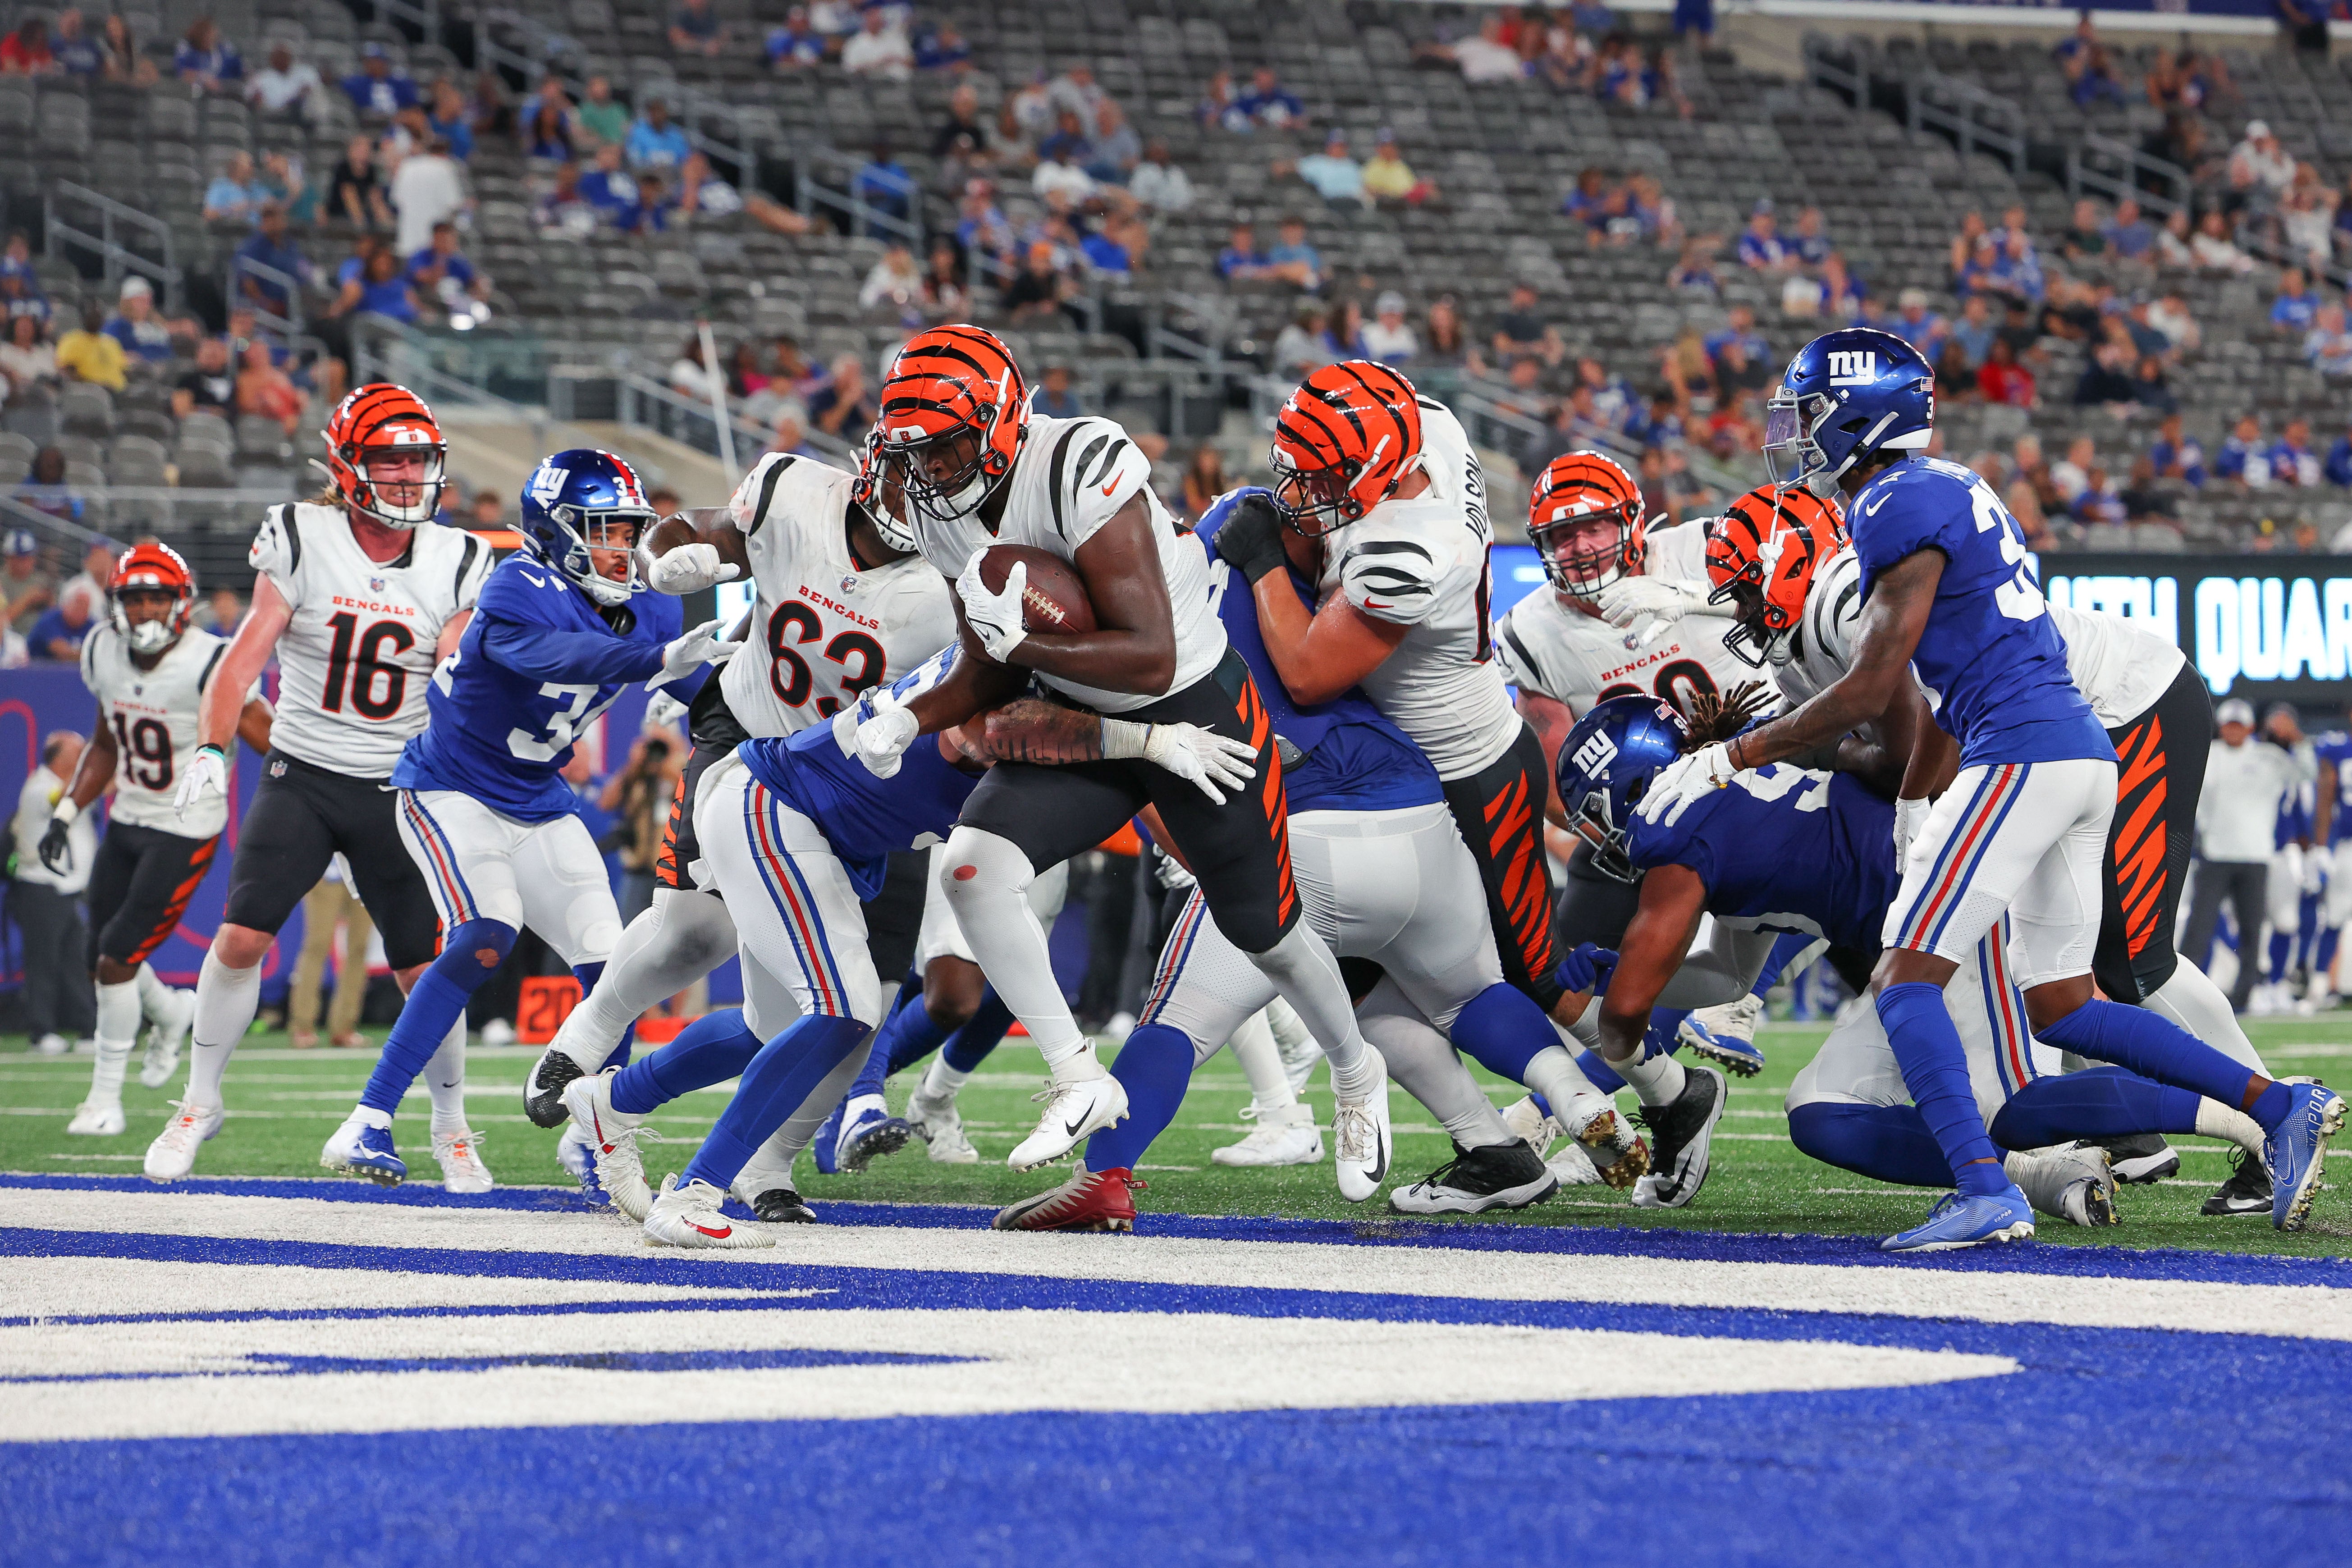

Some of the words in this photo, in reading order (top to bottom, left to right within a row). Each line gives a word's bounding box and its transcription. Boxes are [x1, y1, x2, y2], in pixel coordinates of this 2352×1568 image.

[899, 431, 911, 441] B
[1968, 477, 2046, 622] 3
[332, 595, 415, 616] BENGALS
[798, 585, 879, 630] BENGALS
[322, 610, 415, 720] 16
[768, 599, 887, 719] 63
[1601, 643, 1681, 681] BENGALS
[113, 711, 173, 791] 19
[1994, 1209, 2013, 1223] VAPOR
